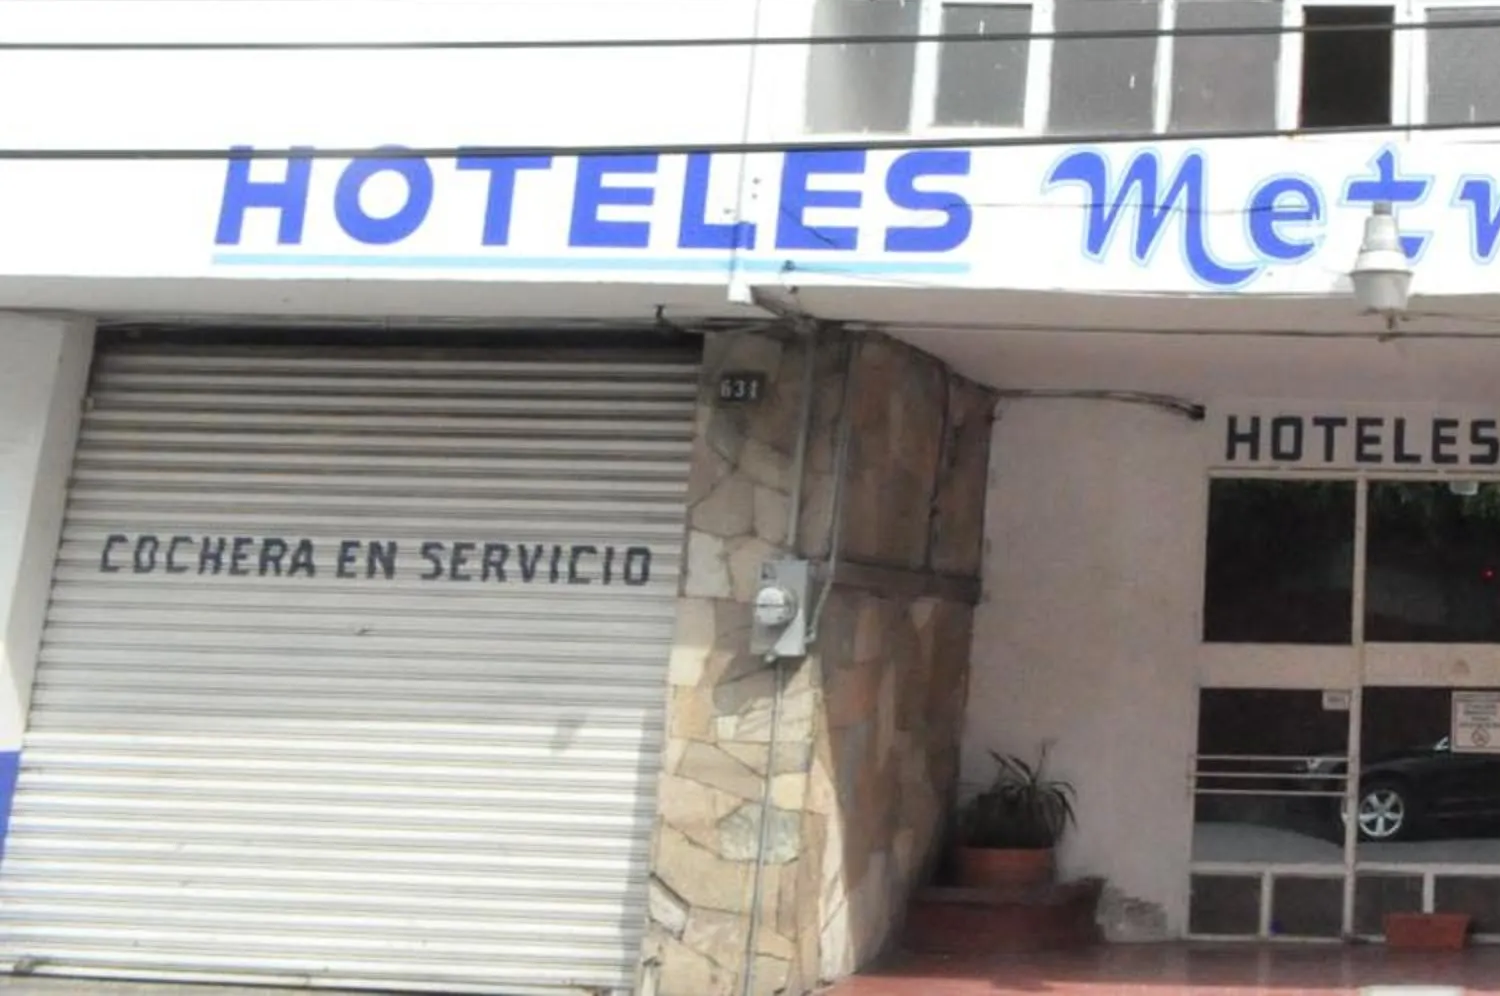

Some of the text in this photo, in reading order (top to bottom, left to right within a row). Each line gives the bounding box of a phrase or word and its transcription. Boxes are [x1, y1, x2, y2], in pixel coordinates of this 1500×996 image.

[214, 145, 973, 252] HOTELES
[721, 379, 759, 399] 631
[1226, 415, 1500, 464] HOTELES
[100, 534, 651, 586] COCHERA EN SERVICIO
